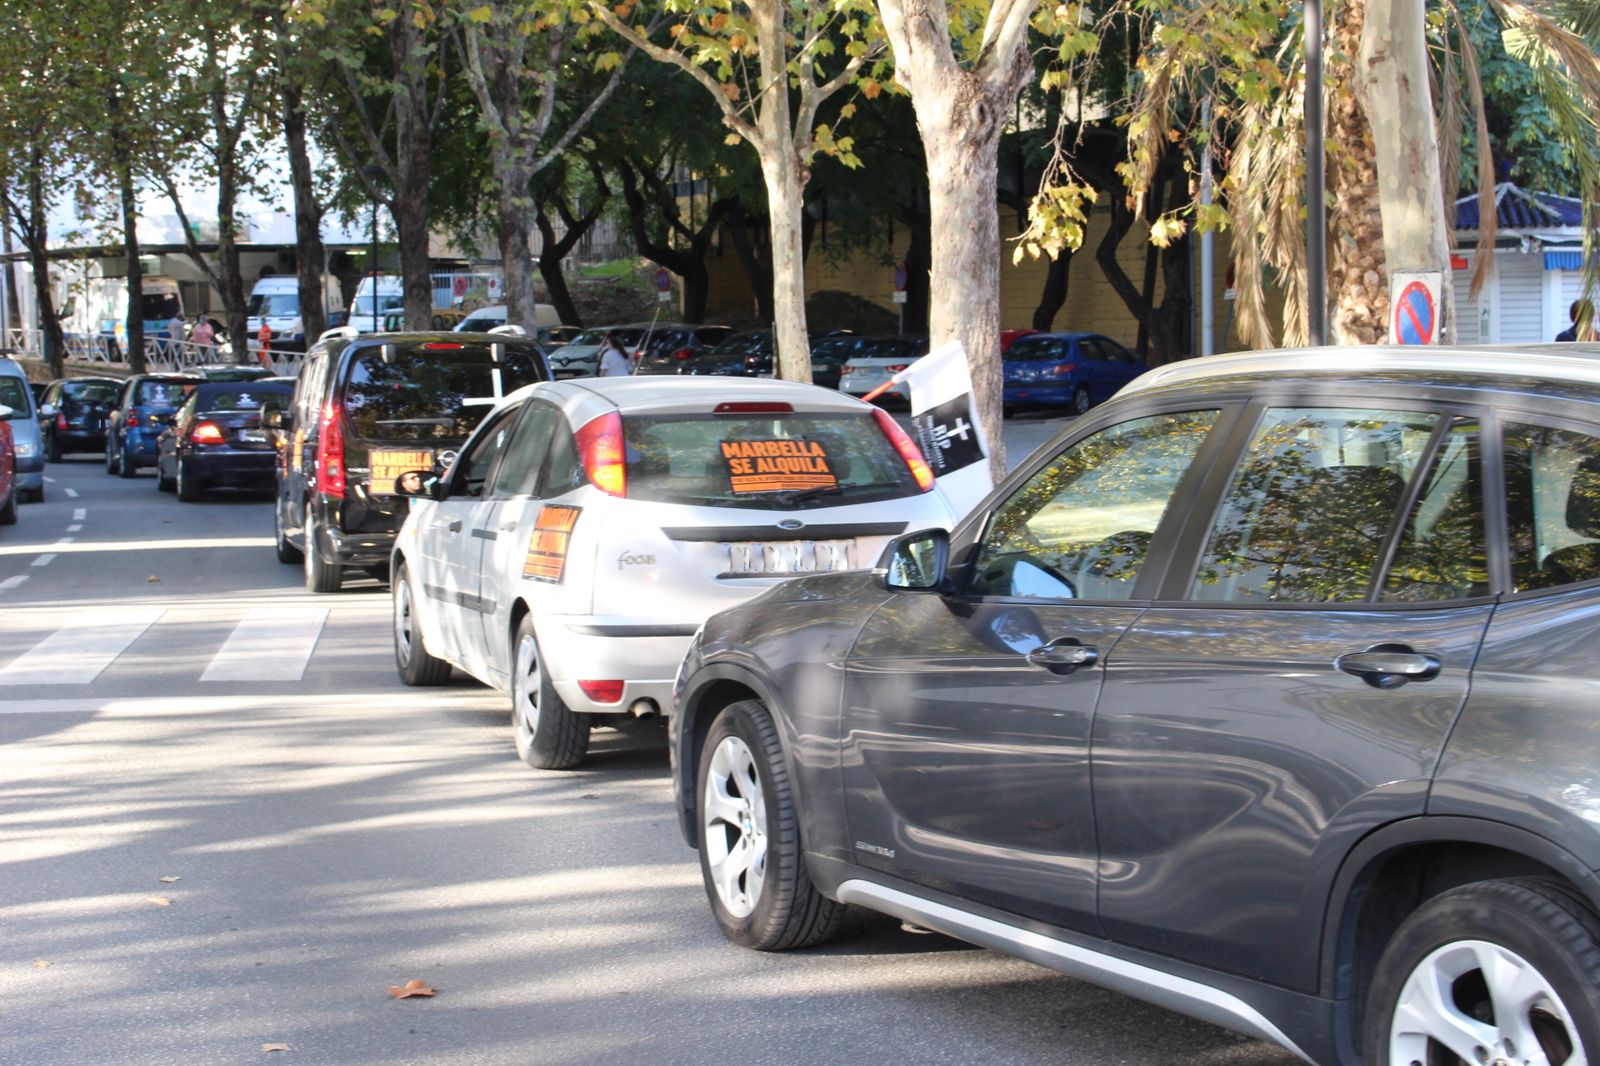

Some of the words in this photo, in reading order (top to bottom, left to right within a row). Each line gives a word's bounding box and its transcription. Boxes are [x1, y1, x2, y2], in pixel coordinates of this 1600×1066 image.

[720, 440, 827, 458] MARBELLA
[370, 451, 433, 467] MARBELLA
[729, 458, 755, 475] SE
[757, 457, 831, 474] ALQUILA
